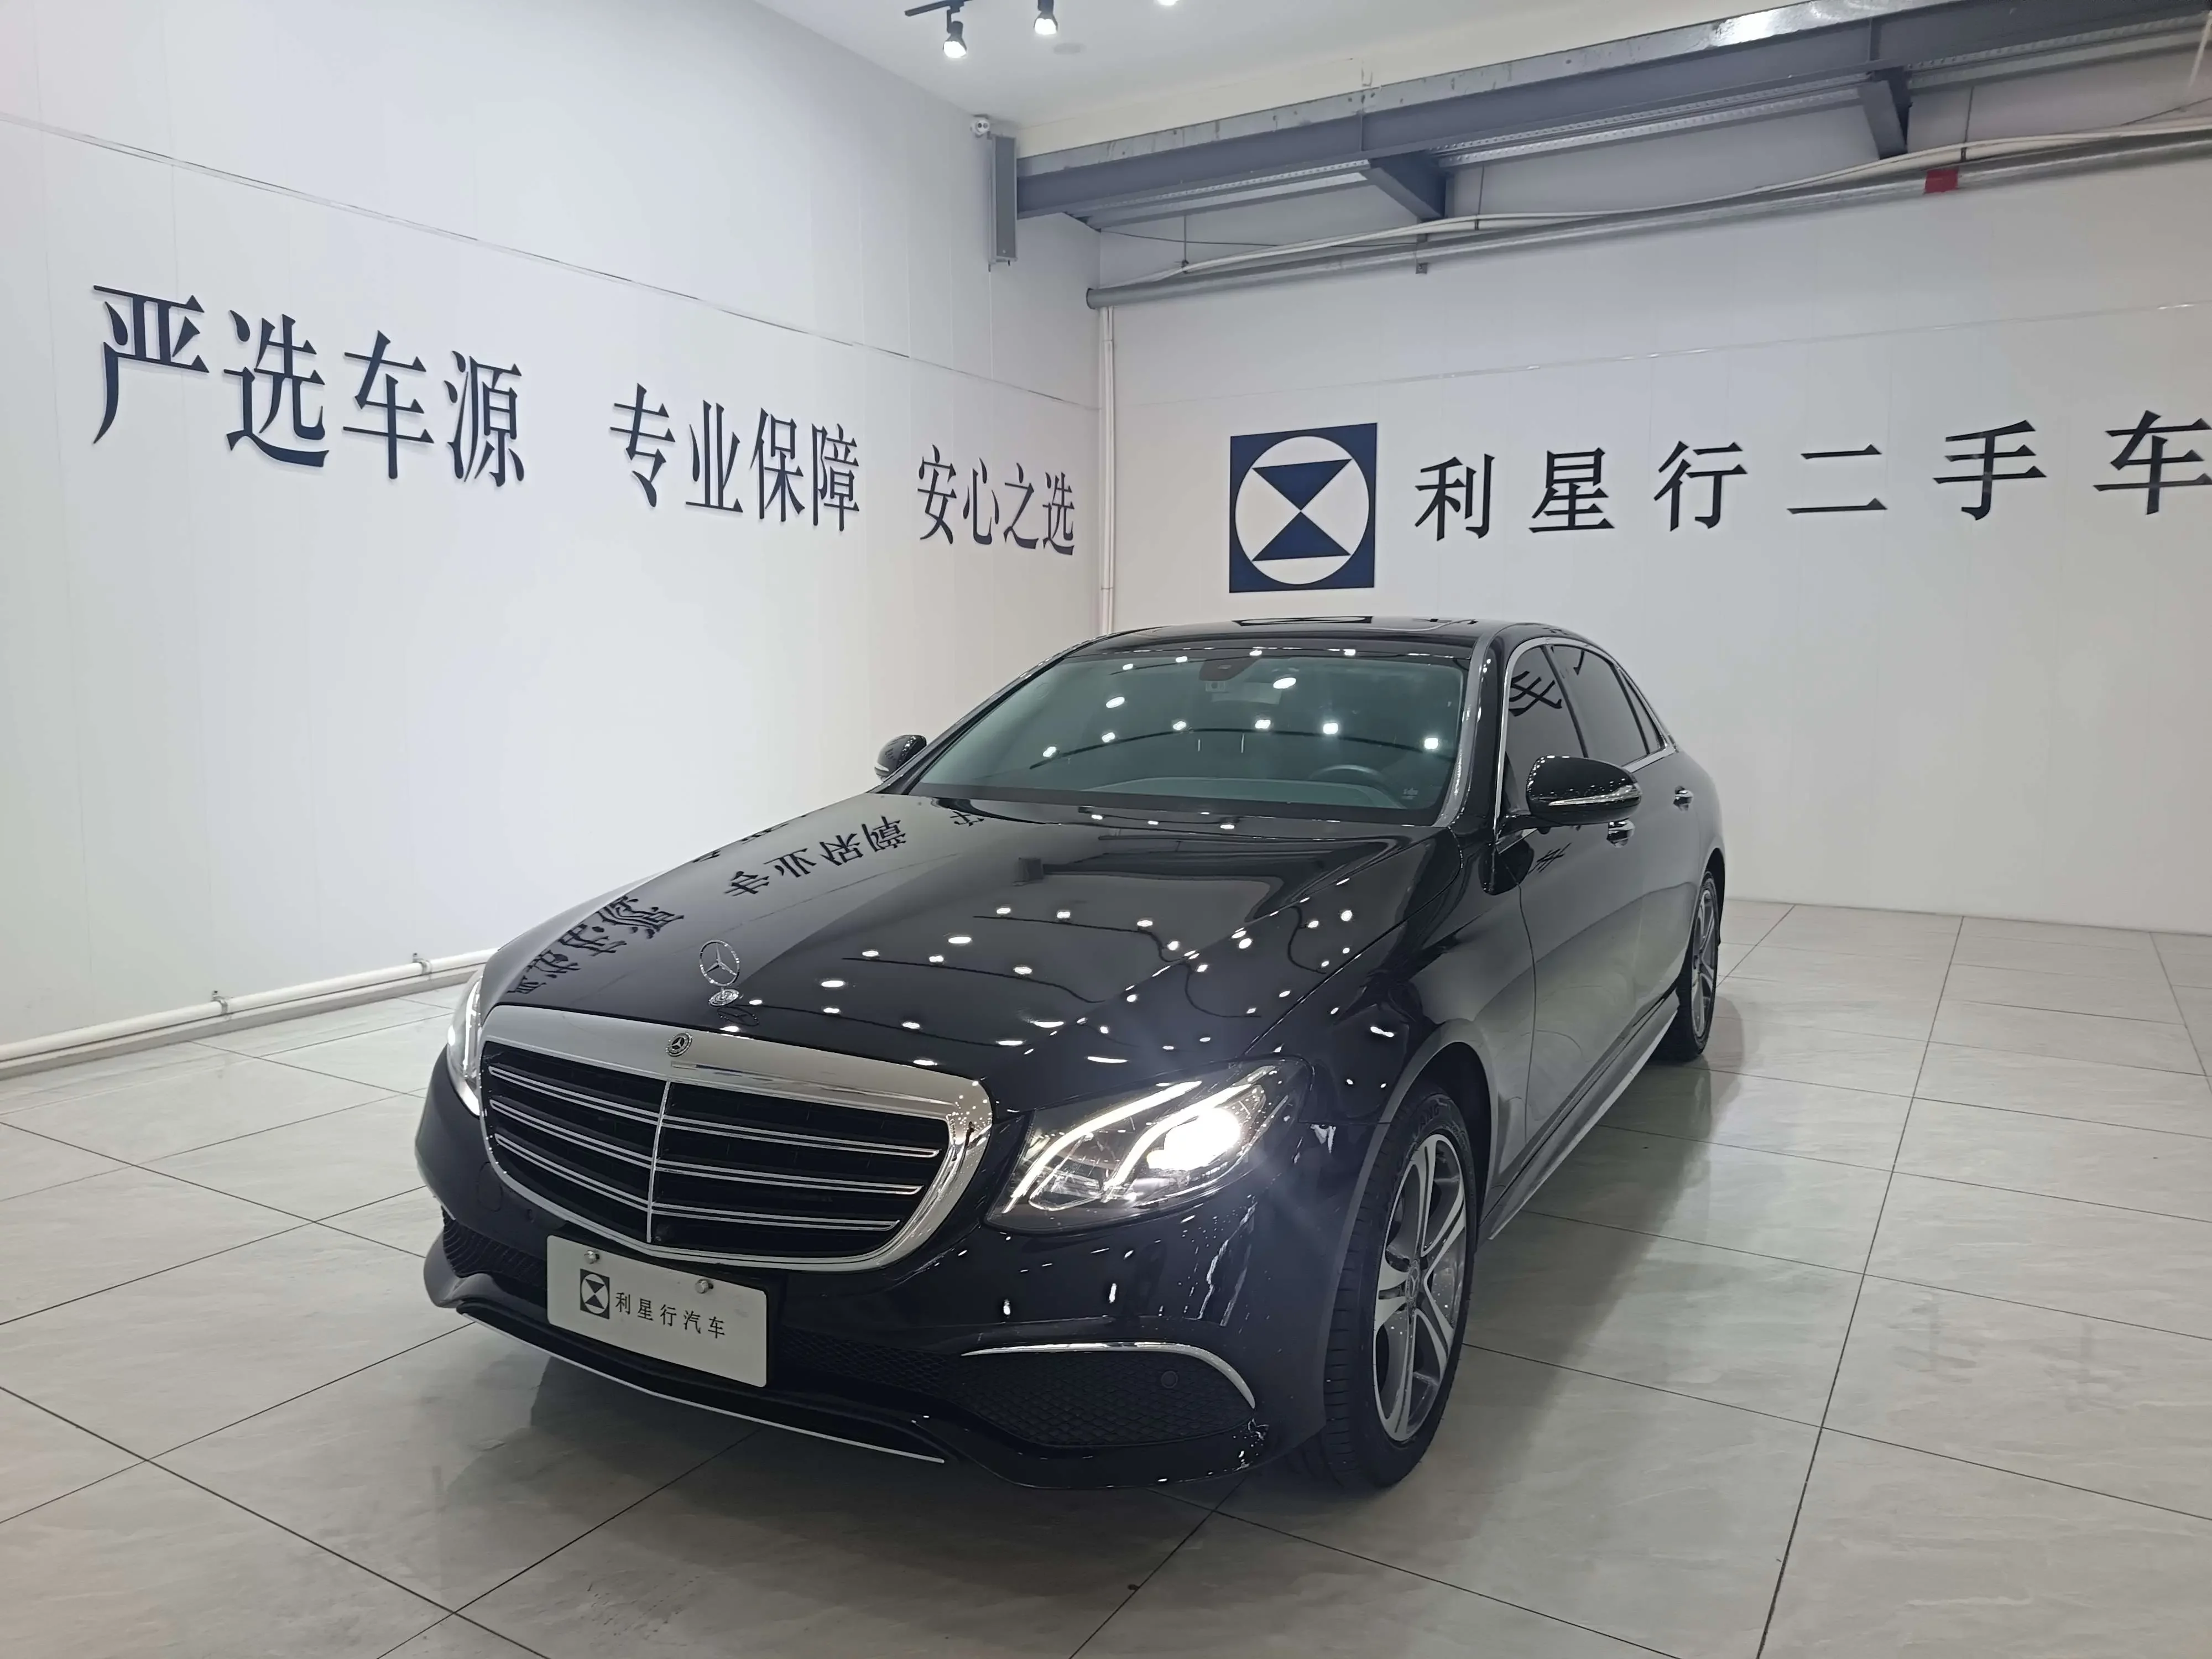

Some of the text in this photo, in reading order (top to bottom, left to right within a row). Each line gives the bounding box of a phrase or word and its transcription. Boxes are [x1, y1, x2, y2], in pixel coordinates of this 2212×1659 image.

[93, 285, 1075, 555] 严选车源 专业保障 安心之选
[1415, 410, 2212, 541] 利星行二手车
[615, 1291, 725, 1339] 利星行汽车
